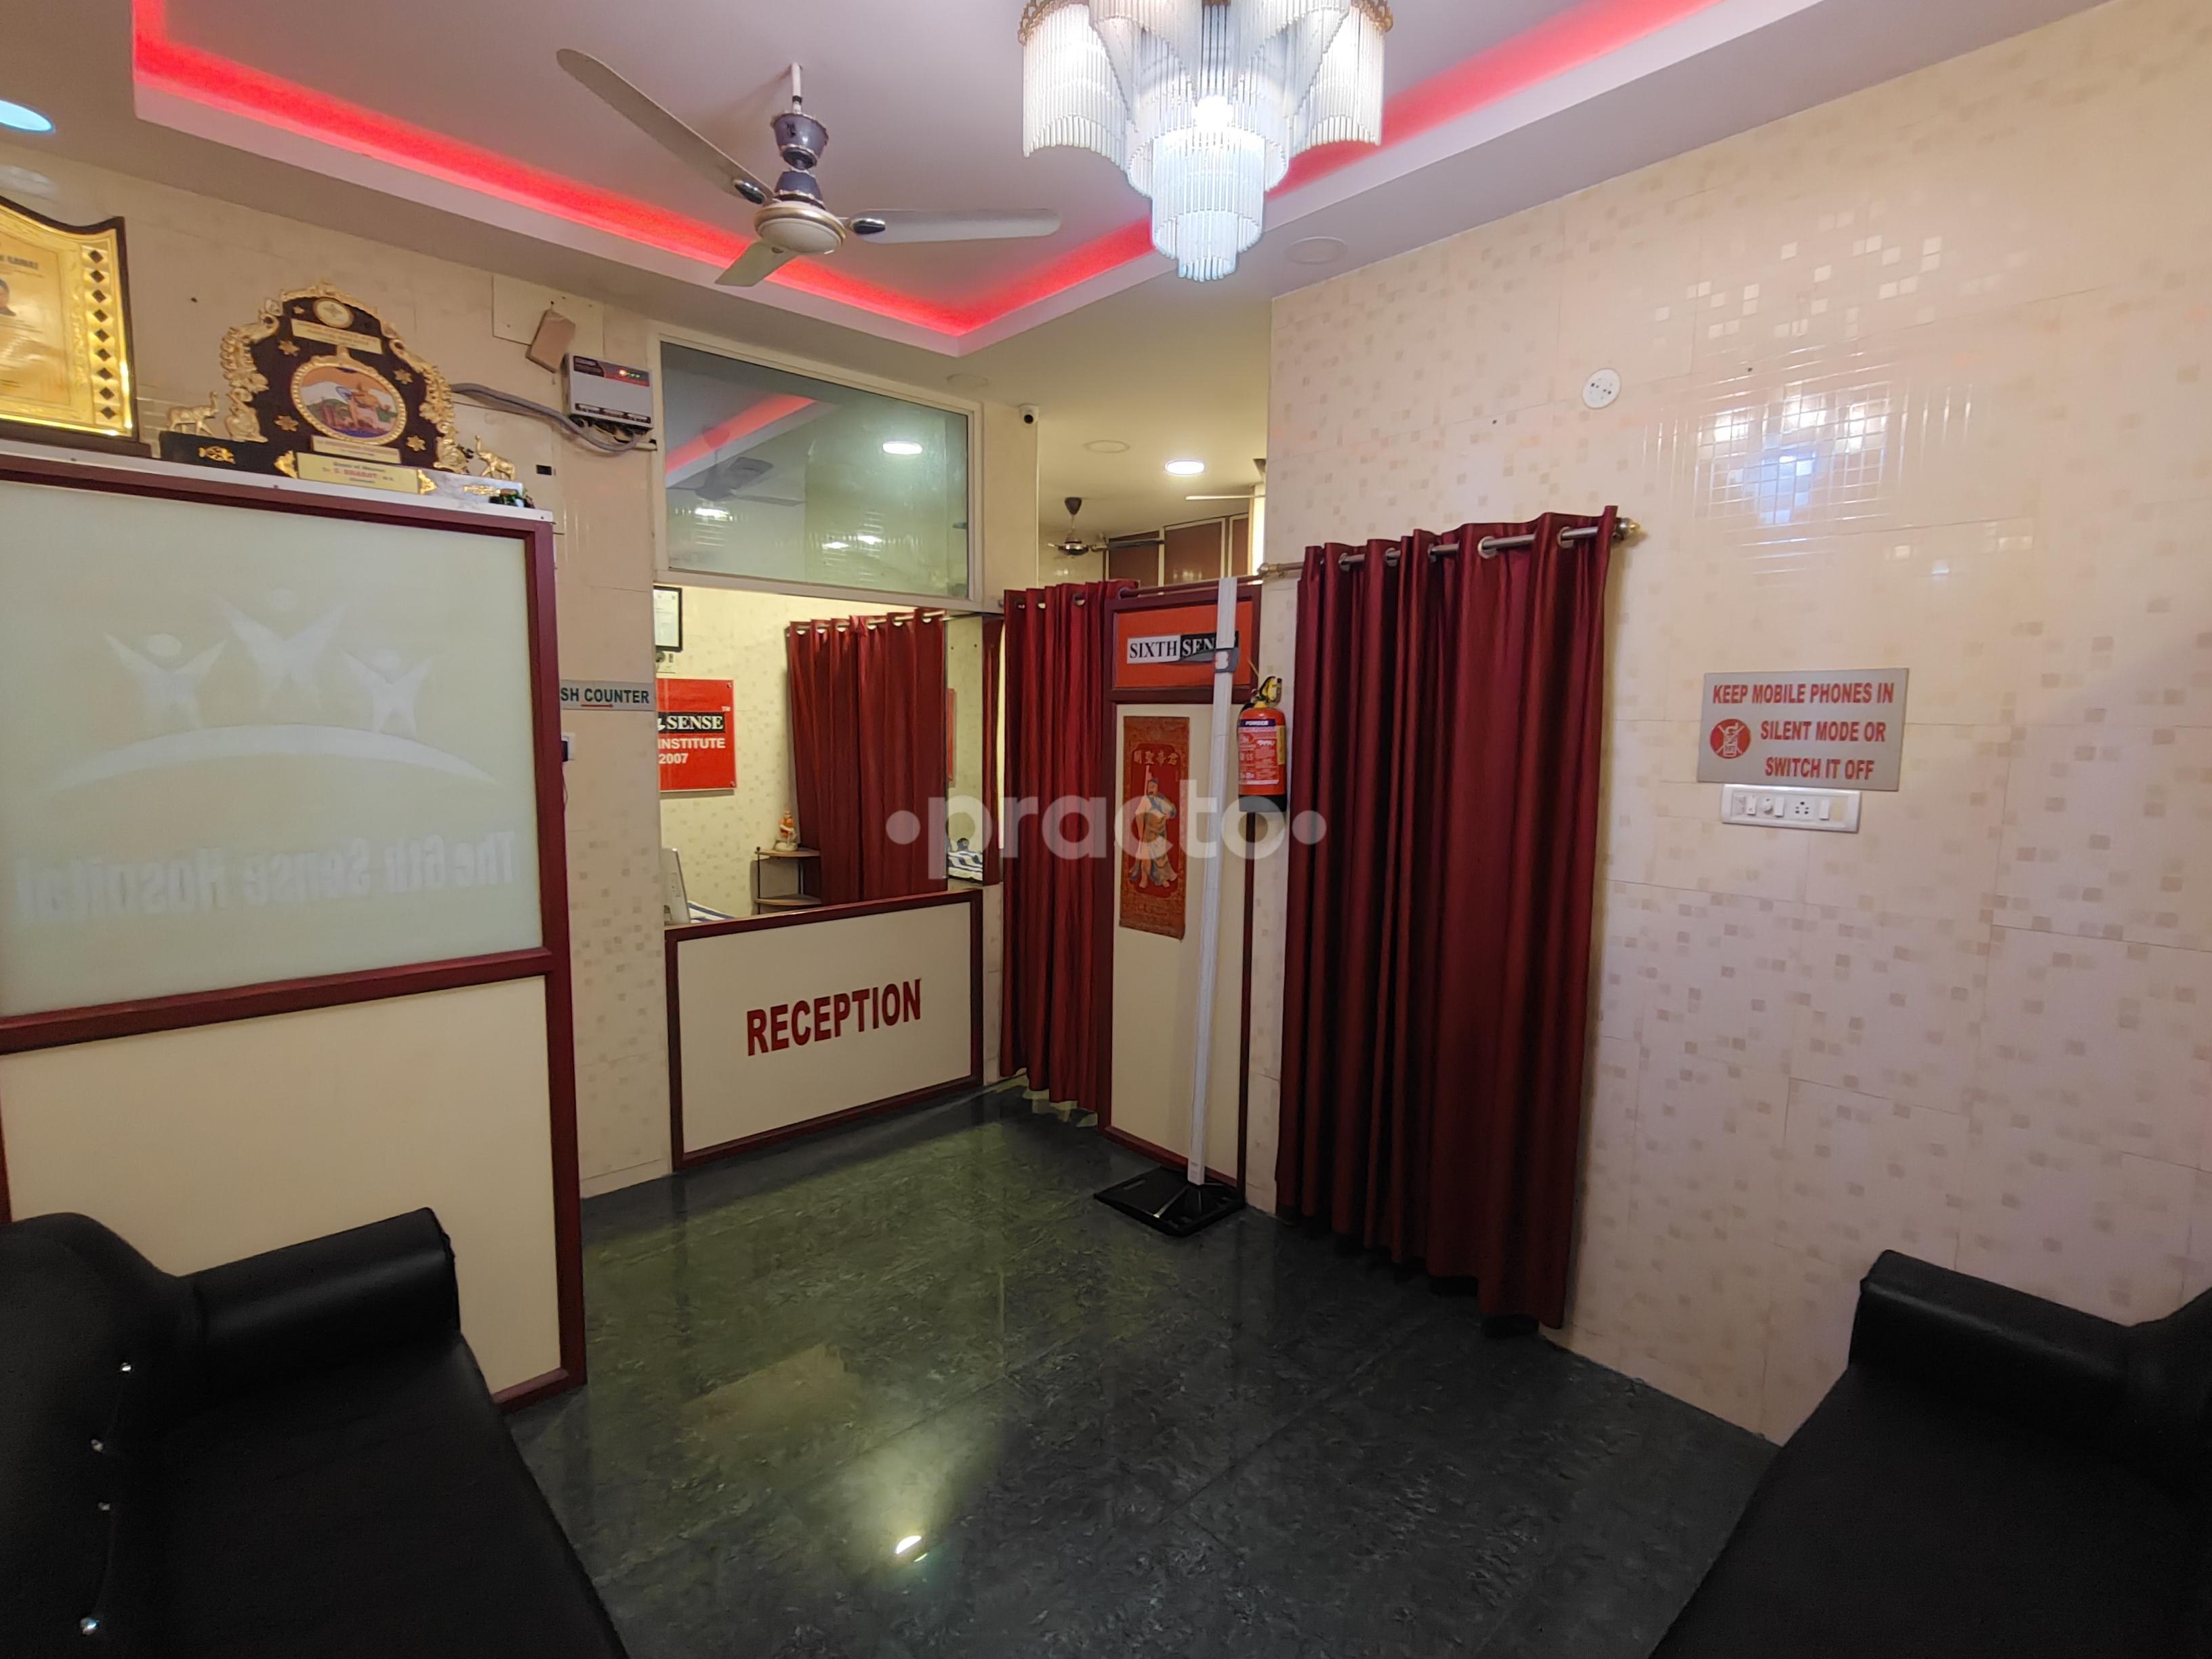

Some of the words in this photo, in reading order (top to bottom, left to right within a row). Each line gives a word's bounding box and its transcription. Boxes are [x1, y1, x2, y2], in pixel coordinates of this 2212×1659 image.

[1130, 641, 1176, 658] SIXTH
[560, 687, 579, 702] SH
[584, 688, 649, 703] COUNTER
[1713, 684, 1748, 703] KEEP
[1752, 684, 1805, 703] MOBILE
[1810, 682, 1872, 703] PHONES
[1877, 682, 1894, 703] IN
[667, 715, 724, 730] SENSE
[1761, 720, 1811, 740] SILENT
[1816, 721, 1860, 741] MODE
[1864, 722, 1886, 742] OR
[658, 737, 726, 749] INSTITUTE
[659, 753, 689, 764] 2007
[1765, 757, 1820, 778] SWITCH
[1825, 759, 1841, 779] IT
[1845, 760, 1875, 779] OFF
[747, 979, 921, 1056] RECEPTION
